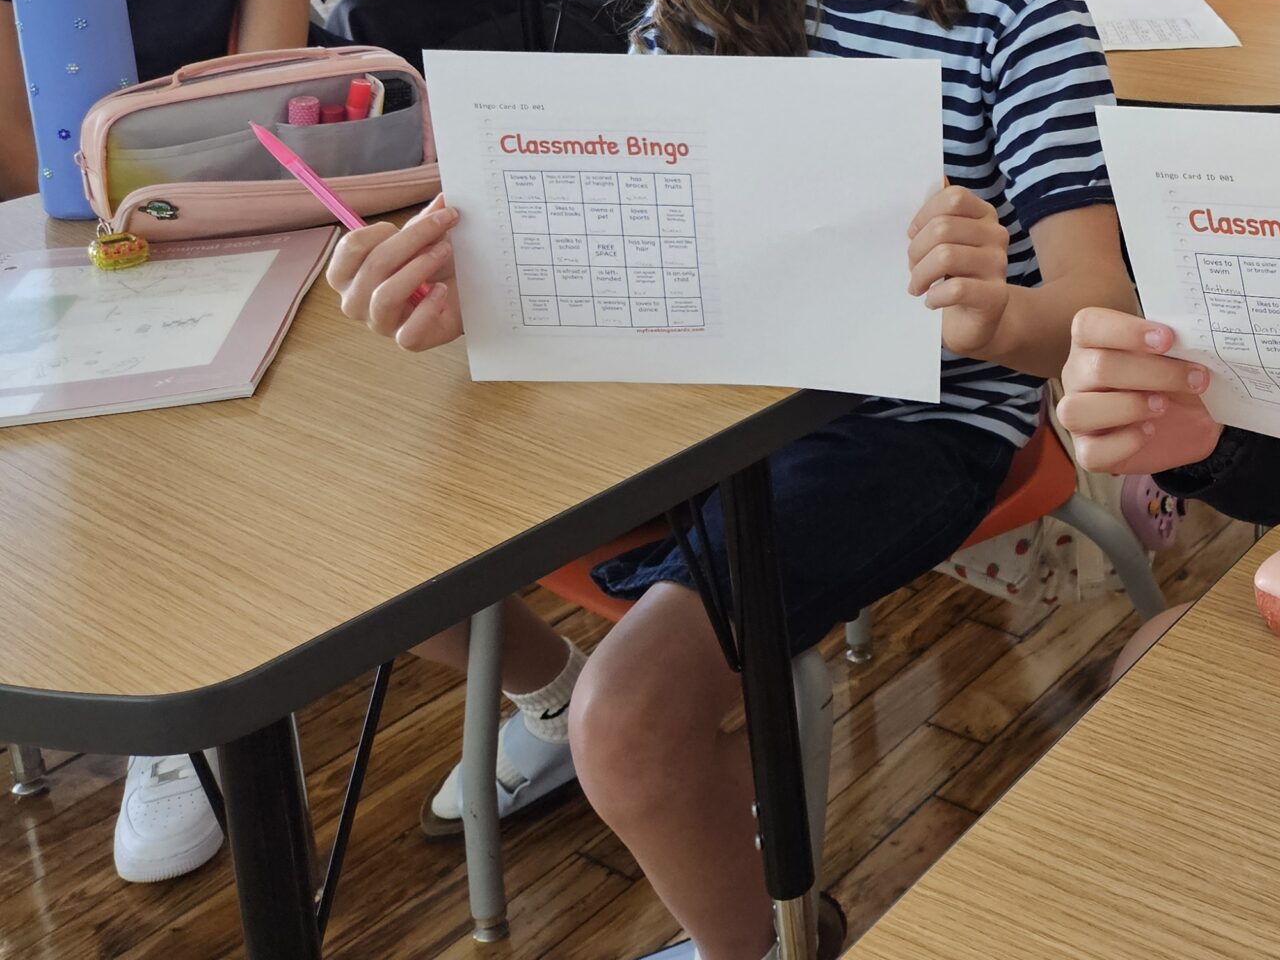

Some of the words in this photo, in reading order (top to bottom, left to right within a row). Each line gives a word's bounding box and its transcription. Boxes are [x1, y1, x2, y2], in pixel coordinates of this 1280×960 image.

[500, 133, 620, 155] Classmate
[626, 136, 689, 165] Bingo
[1155, 171, 1179, 181] Bingo
[1182, 172, 1202, 181] Card
[1206, 173, 1216, 181] ID
[1219, 174, 1234, 182] 001
[1203, 258, 1223, 266] loves
[1224, 259, 1233, 267] to
[1209, 267, 1230, 275] swim
[1256, 300, 1271, 308] likes
